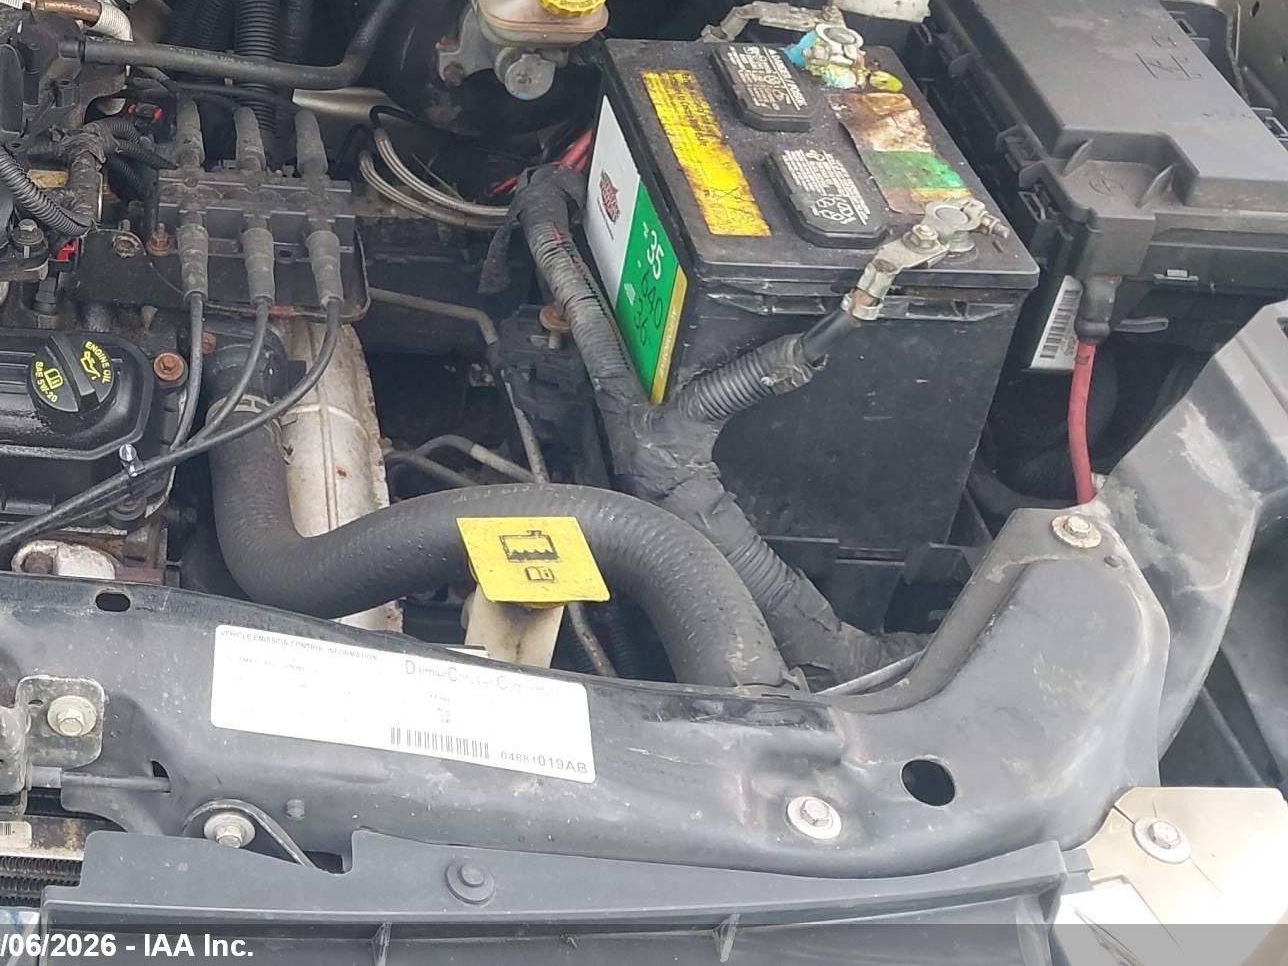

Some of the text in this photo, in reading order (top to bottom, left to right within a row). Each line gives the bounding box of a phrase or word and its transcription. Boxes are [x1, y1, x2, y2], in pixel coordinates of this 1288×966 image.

[645, 224, 664, 280] 35
[35, 361, 59, 402] SAE 5W-20
[85, 341, 113, 384] ENGINE OIL
[220, 630, 379, 661] VEHICLE EMISSION CONTROL INFORMATION
